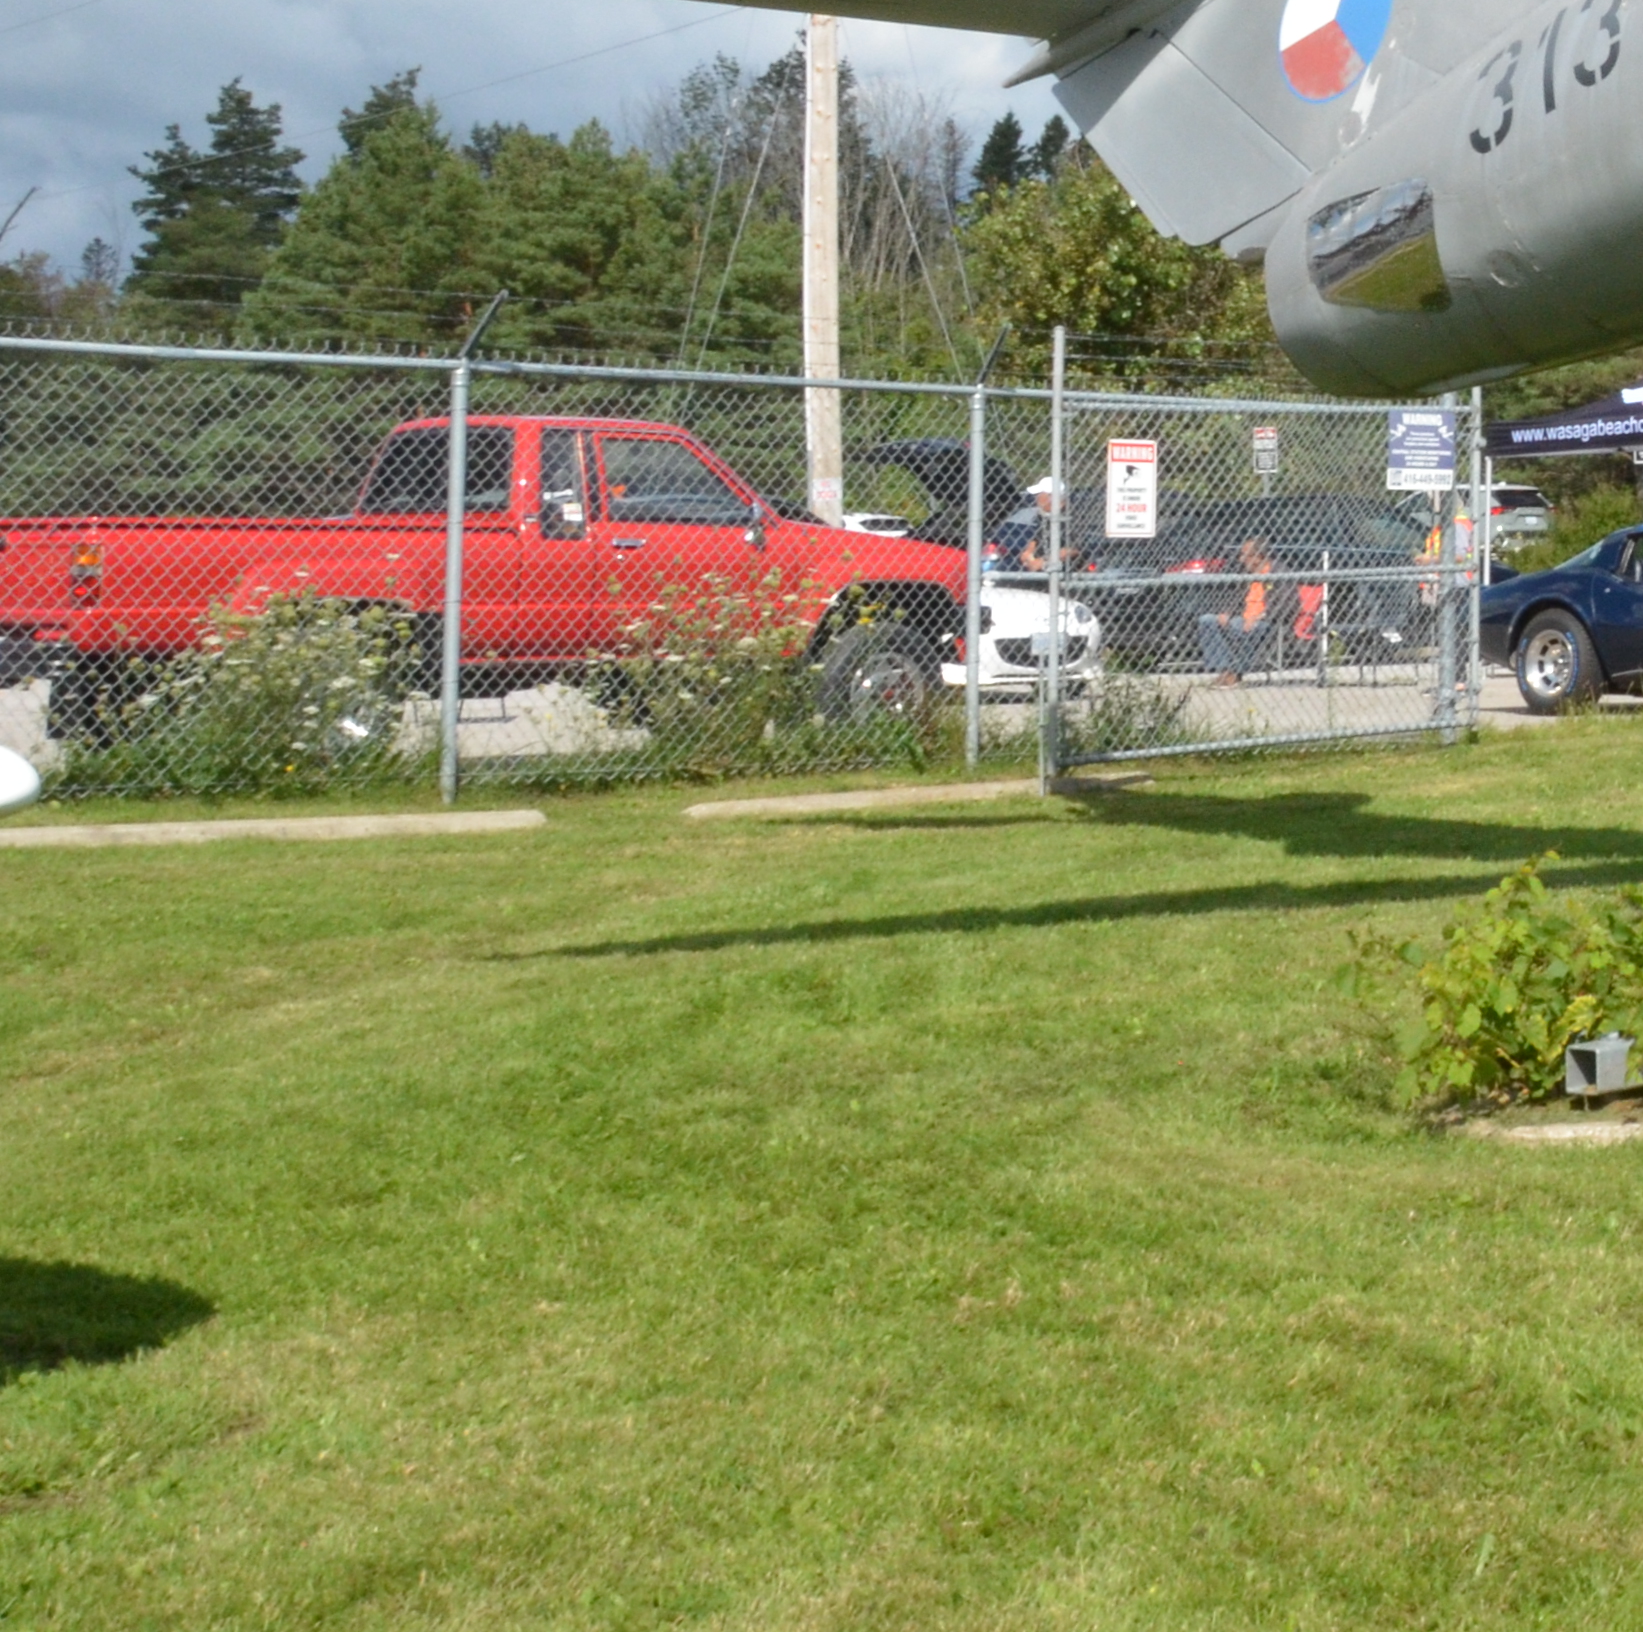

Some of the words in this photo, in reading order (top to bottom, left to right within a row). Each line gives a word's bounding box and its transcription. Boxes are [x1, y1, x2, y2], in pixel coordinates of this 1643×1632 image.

[1402, 413, 1443, 426] WARNING
[1113, 446, 1153, 461] WARNING
[1116, 503, 1126, 513] 24
[1126, 503, 1147, 513] HOUR
